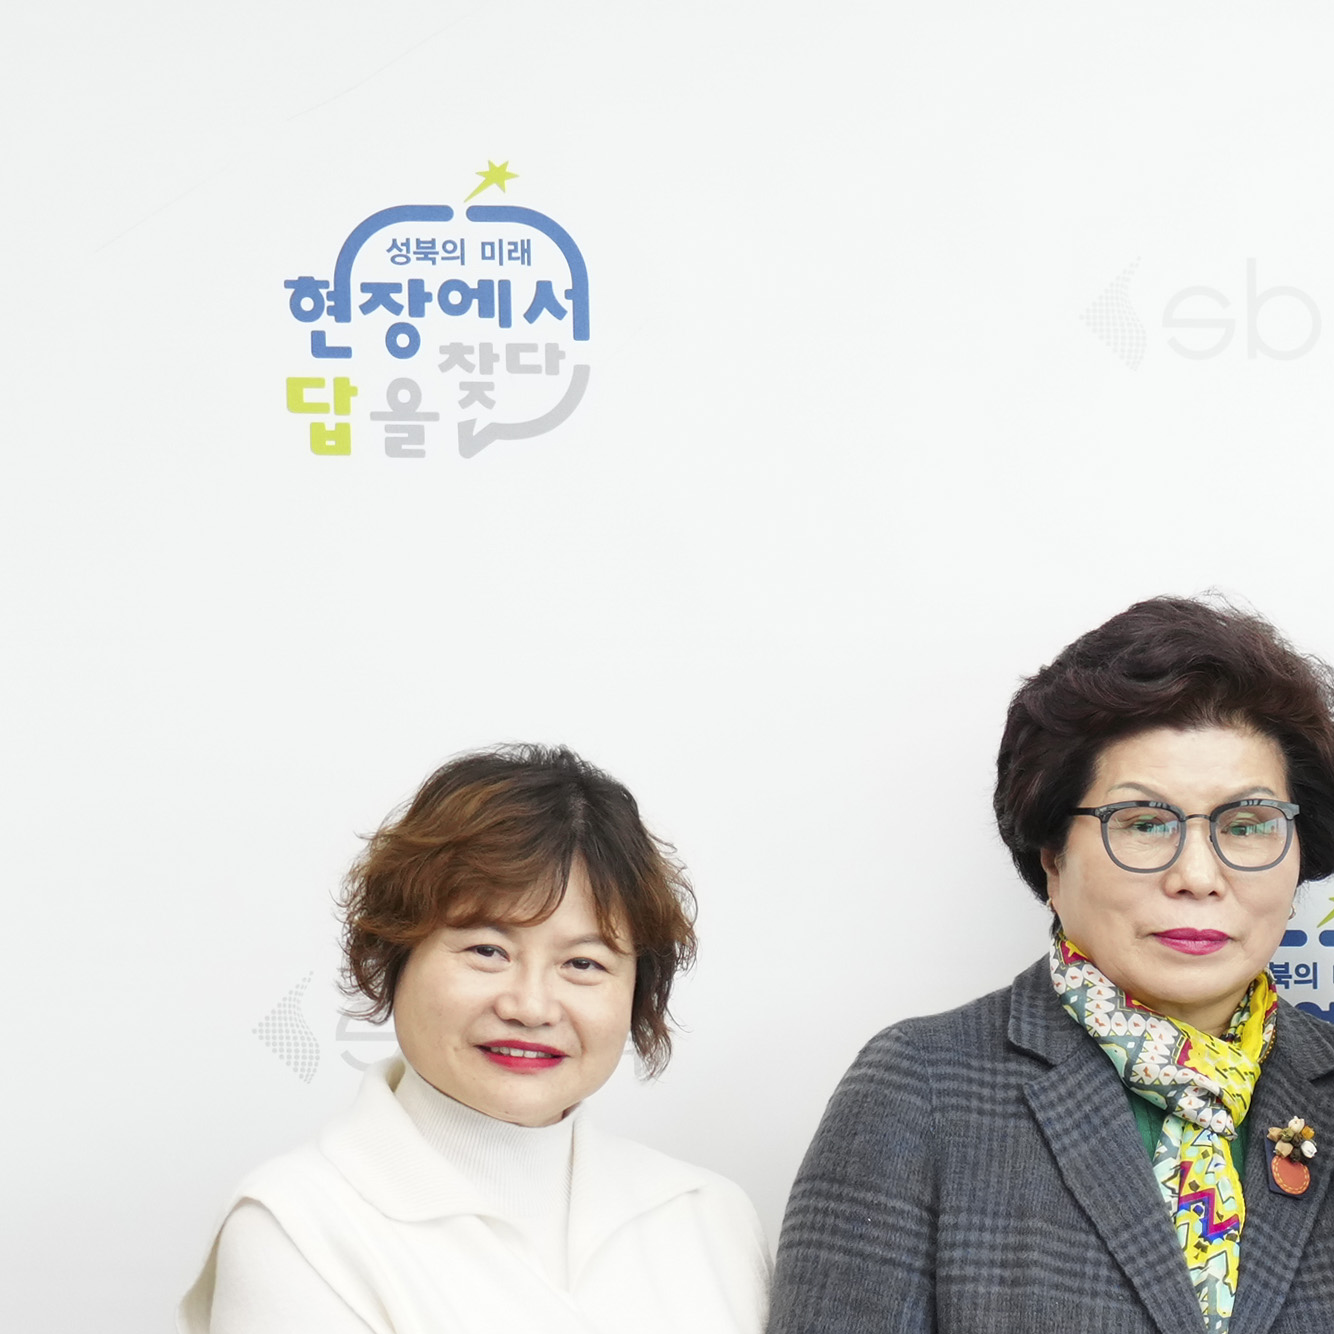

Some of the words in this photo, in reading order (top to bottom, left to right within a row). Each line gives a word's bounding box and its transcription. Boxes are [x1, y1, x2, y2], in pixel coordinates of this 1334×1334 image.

[386, 238, 465, 266] 성북의
[481, 238, 532, 266] 미래
[284, 276, 590, 359] 현장에서
[1162, 257, 1322, 361] sb
[1268, 962, 1318, 990] 북의
